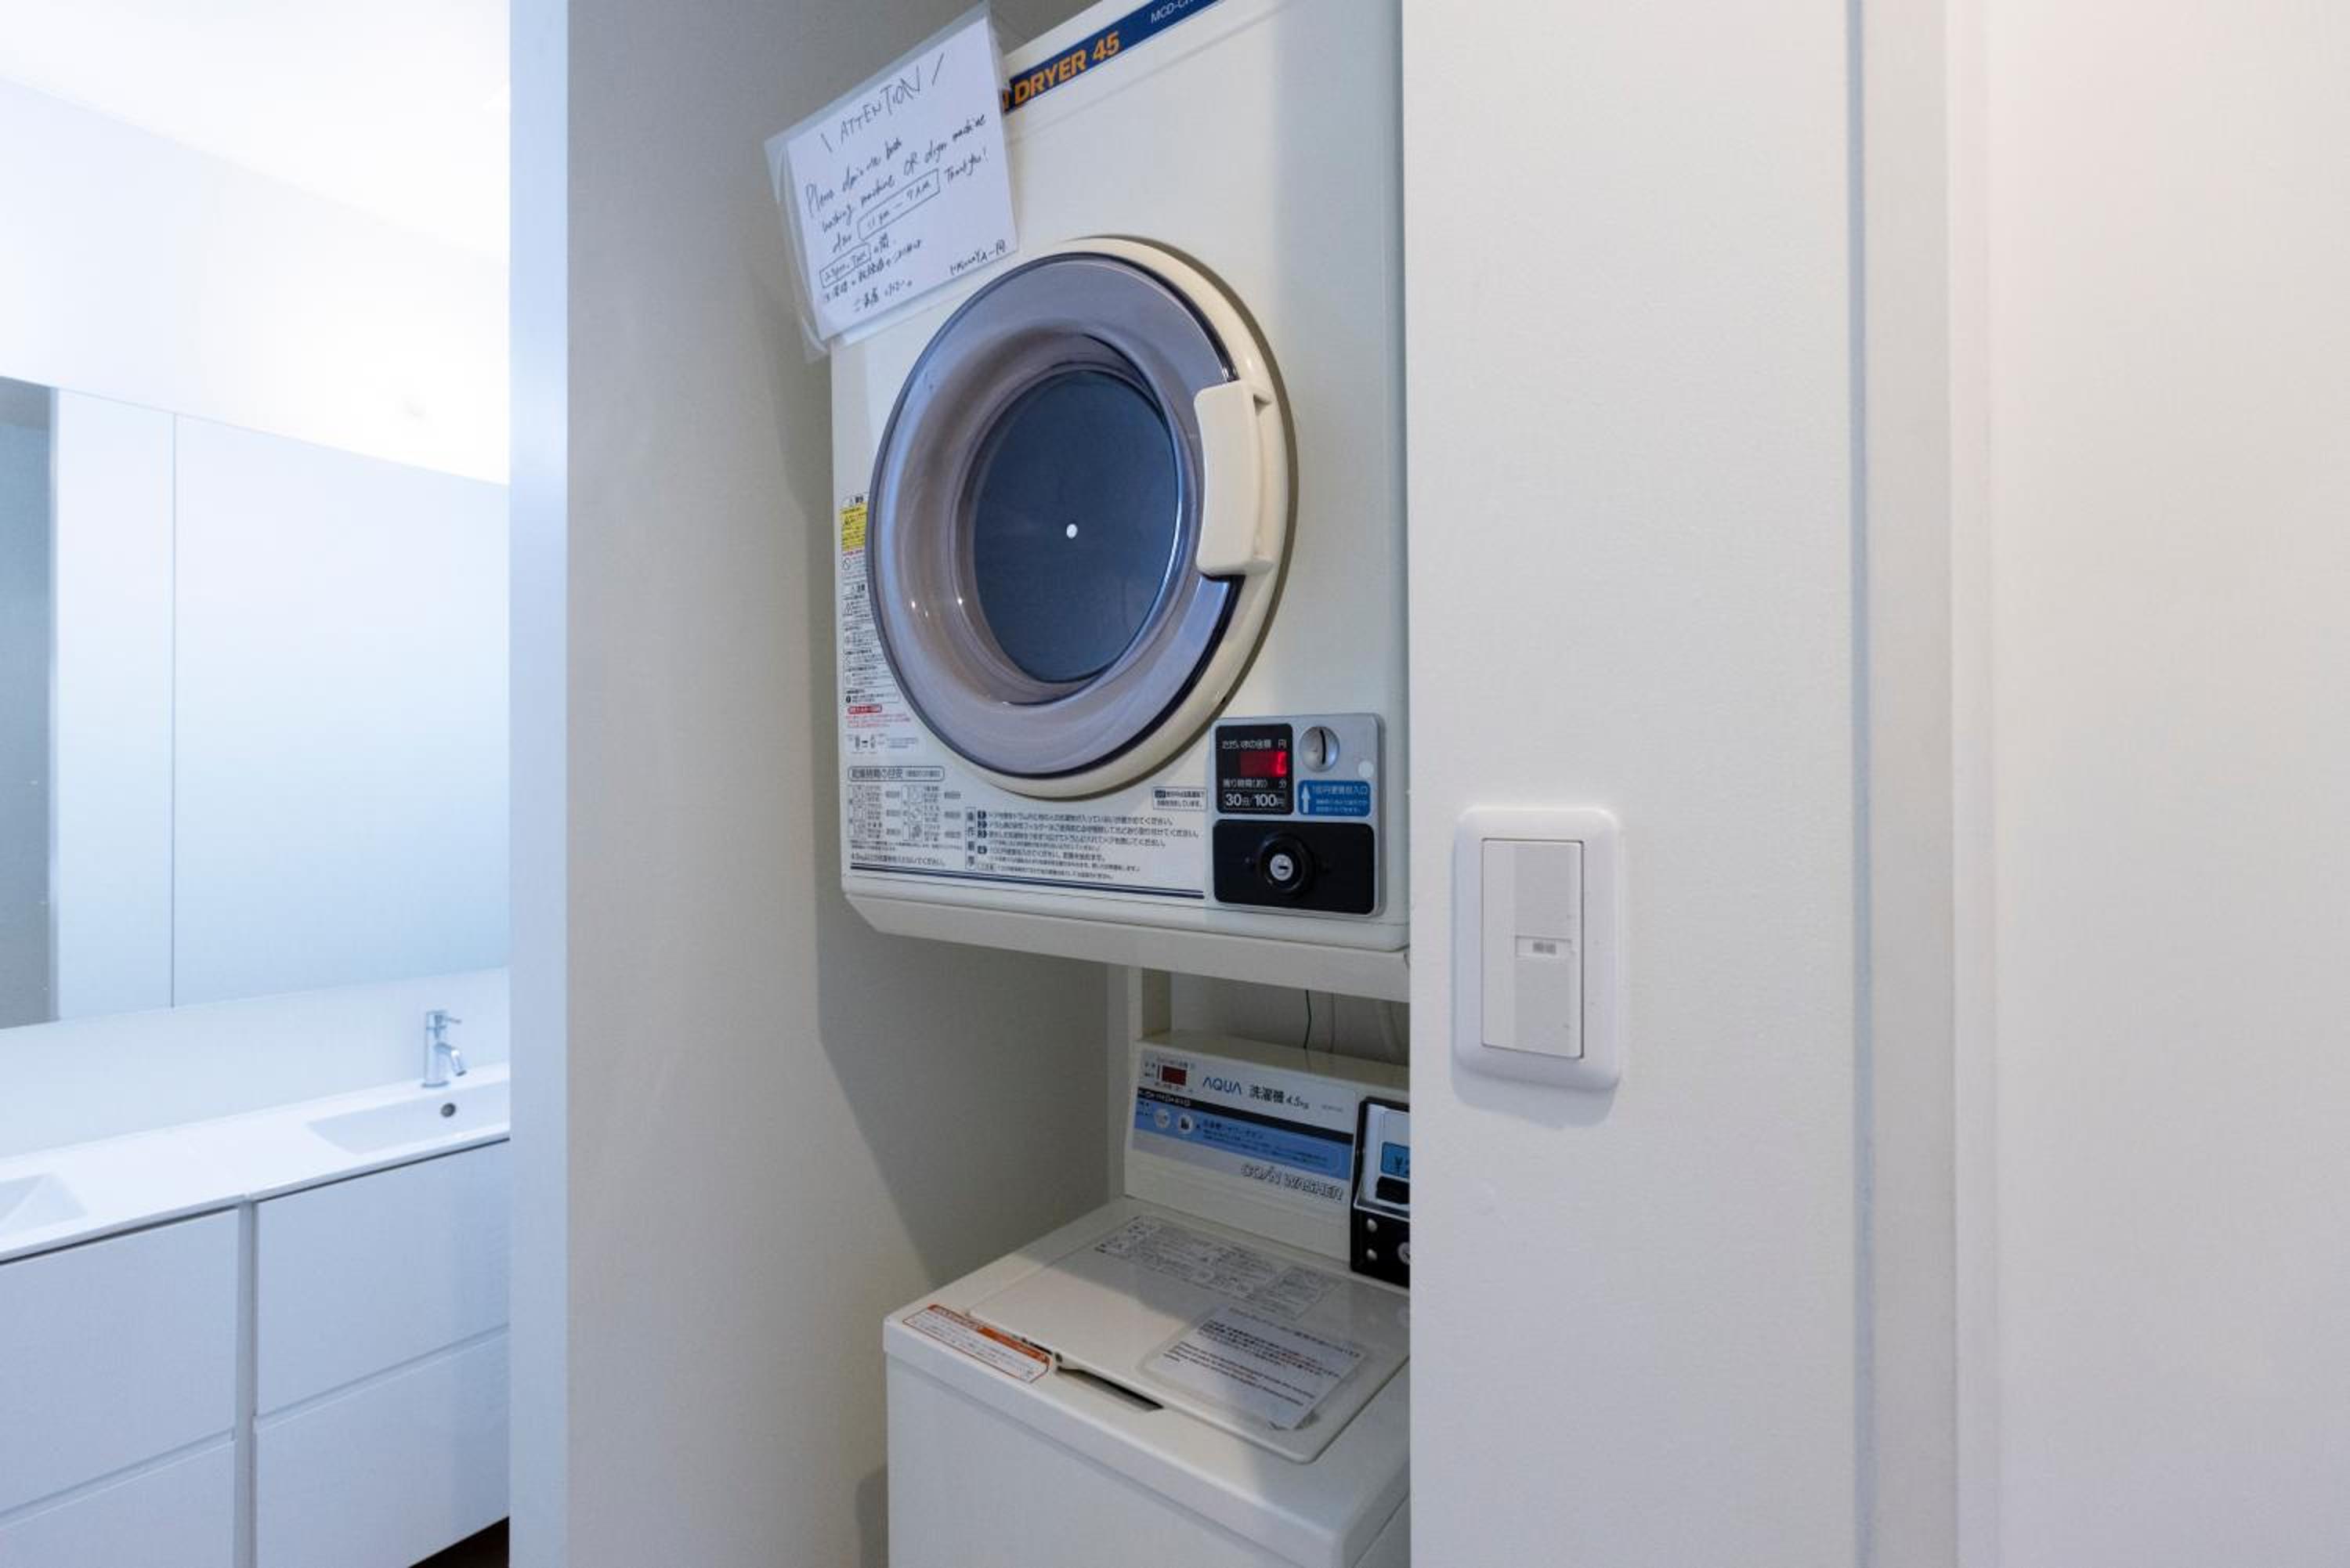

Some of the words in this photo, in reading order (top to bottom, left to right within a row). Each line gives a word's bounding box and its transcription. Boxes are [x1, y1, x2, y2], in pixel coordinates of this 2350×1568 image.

[1014, 49, 1086, 104] DRYER
[1093, 31, 1121, 61] 45
[841, 66, 921, 143] ATTENTION
[1202, 1075, 1242, 1095] AQUA
[1249, 1084, 1285, 1104] 洗濯機
[1241, 1165, 1282, 1186] COIN
[1284, 1173, 1343, 1202] WASHER
